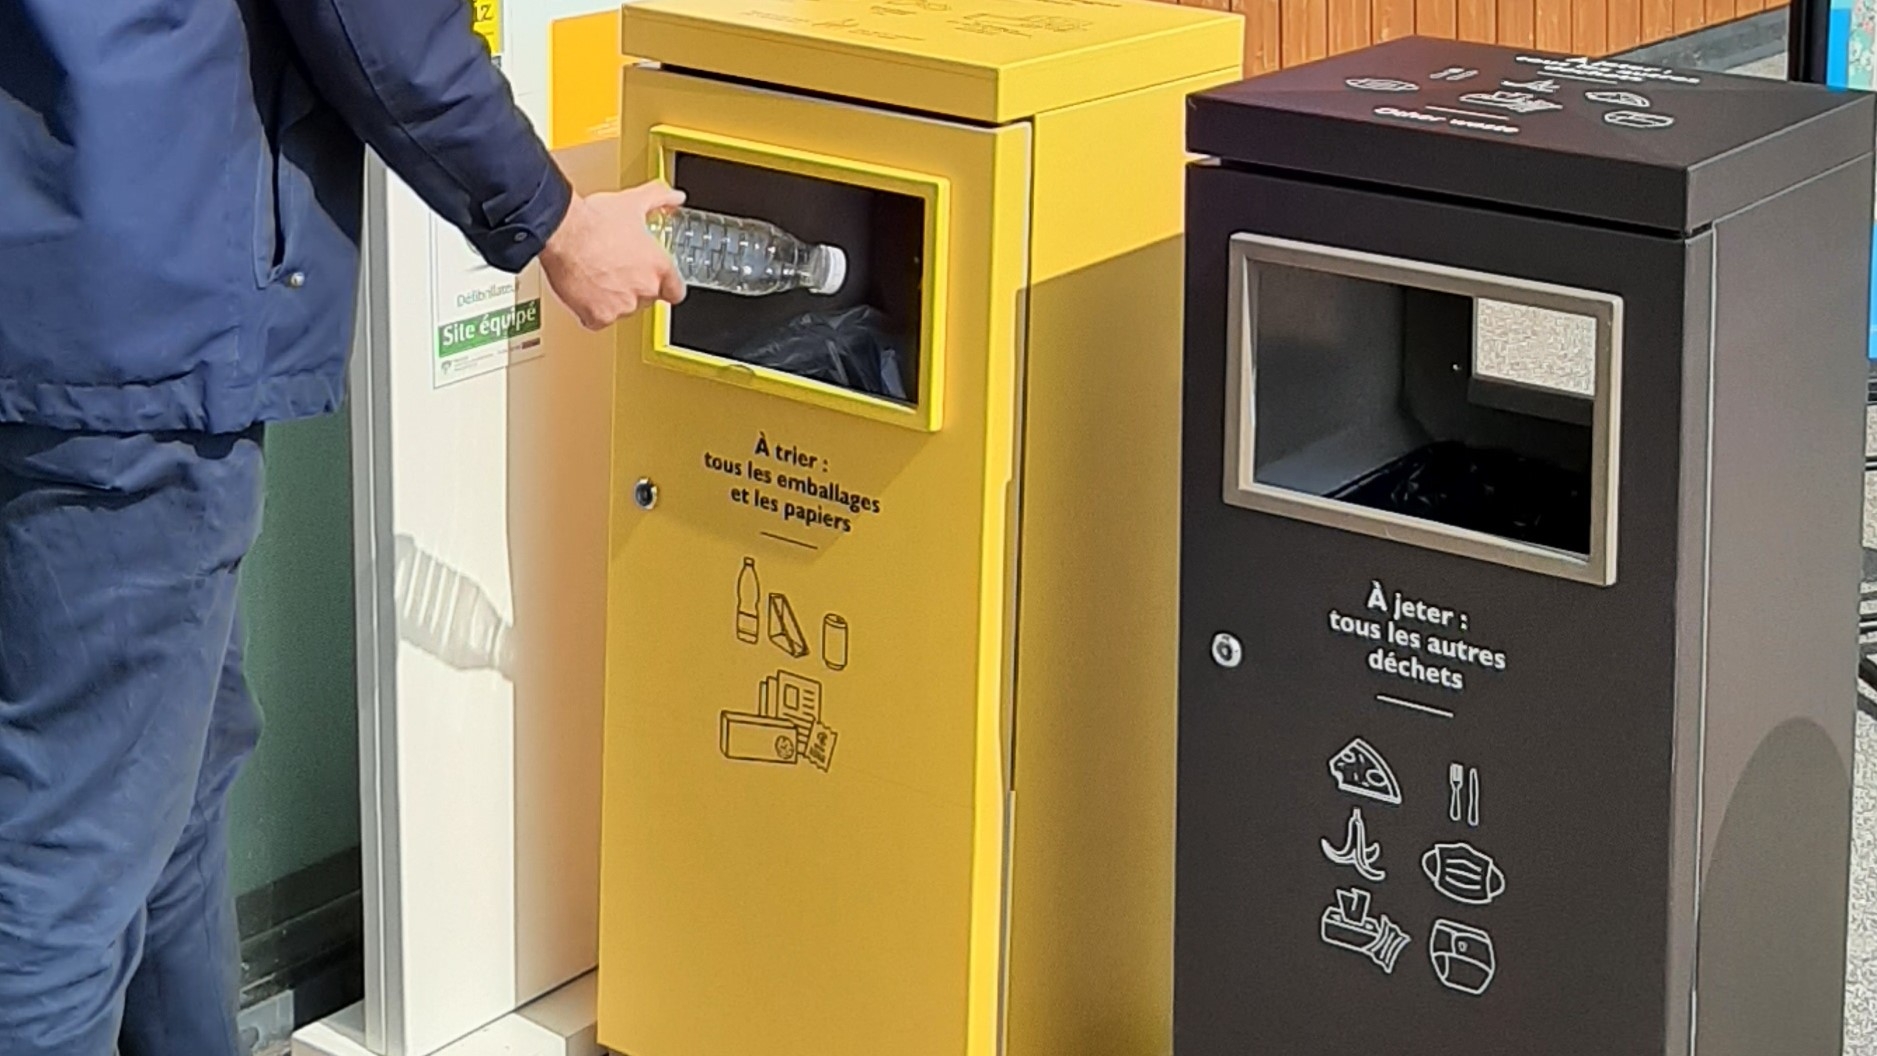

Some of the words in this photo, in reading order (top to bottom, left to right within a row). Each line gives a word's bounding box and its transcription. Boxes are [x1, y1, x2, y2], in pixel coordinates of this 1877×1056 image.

[442, 323, 476, 346] Site
[479, 301, 537, 338] équipé
[754, 430, 770, 457] À
[775, 444, 818, 469] trier
[821, 458, 829, 473] :
[703, 451, 743, 476] tous
[747, 460, 773, 485] les
[776, 475, 881, 514] emballages
[730, 487, 750, 505] et
[753, 488, 779, 513] les
[783, 502, 852, 533] papiers
[1366, 579, 1388, 613] À
[1393, 592, 1455, 626] jeter
[1459, 613, 1469, 631] :
[1328, 609, 1382, 640] tous
[1387, 620, 1421, 649] les
[1426, 636, 1507, 670] autres
[1367, 648, 1464, 690] déchets
